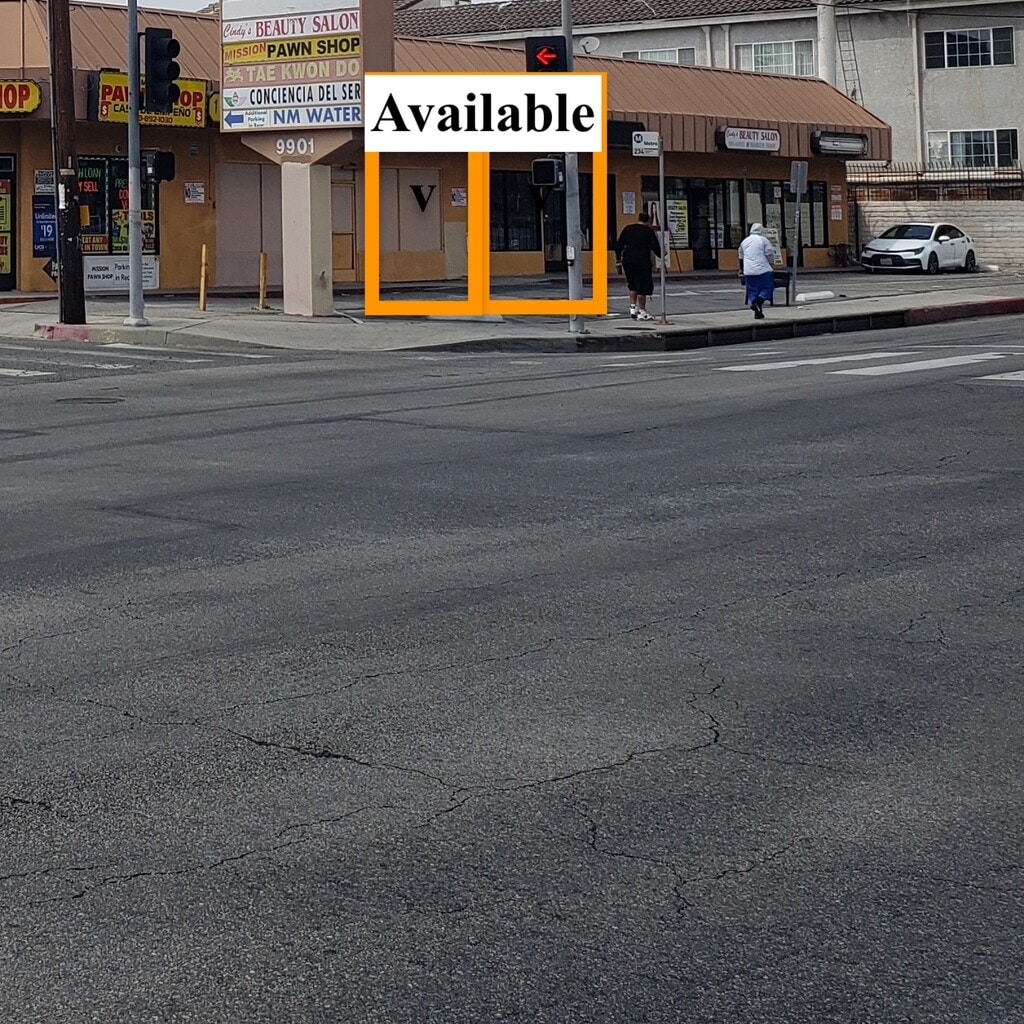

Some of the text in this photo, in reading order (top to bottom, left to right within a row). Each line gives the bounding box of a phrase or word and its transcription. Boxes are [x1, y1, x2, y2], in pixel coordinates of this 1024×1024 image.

[224, 12, 359, 40] Cindy's BEAUTY SALON
[224, 37, 360, 62] MISSION PAWN SHOP
[246, 58, 360, 83] TAE KWON DO
[250, 82, 361, 106] CONCIENCIA DEL SER
[114, 104, 129, 113] CAS
[273, 106, 361, 126] NM WATER
[276, 138, 314, 154] 9901
[739, 131, 758, 140] BEAUTY
[761, 132, 778, 141] SALON
